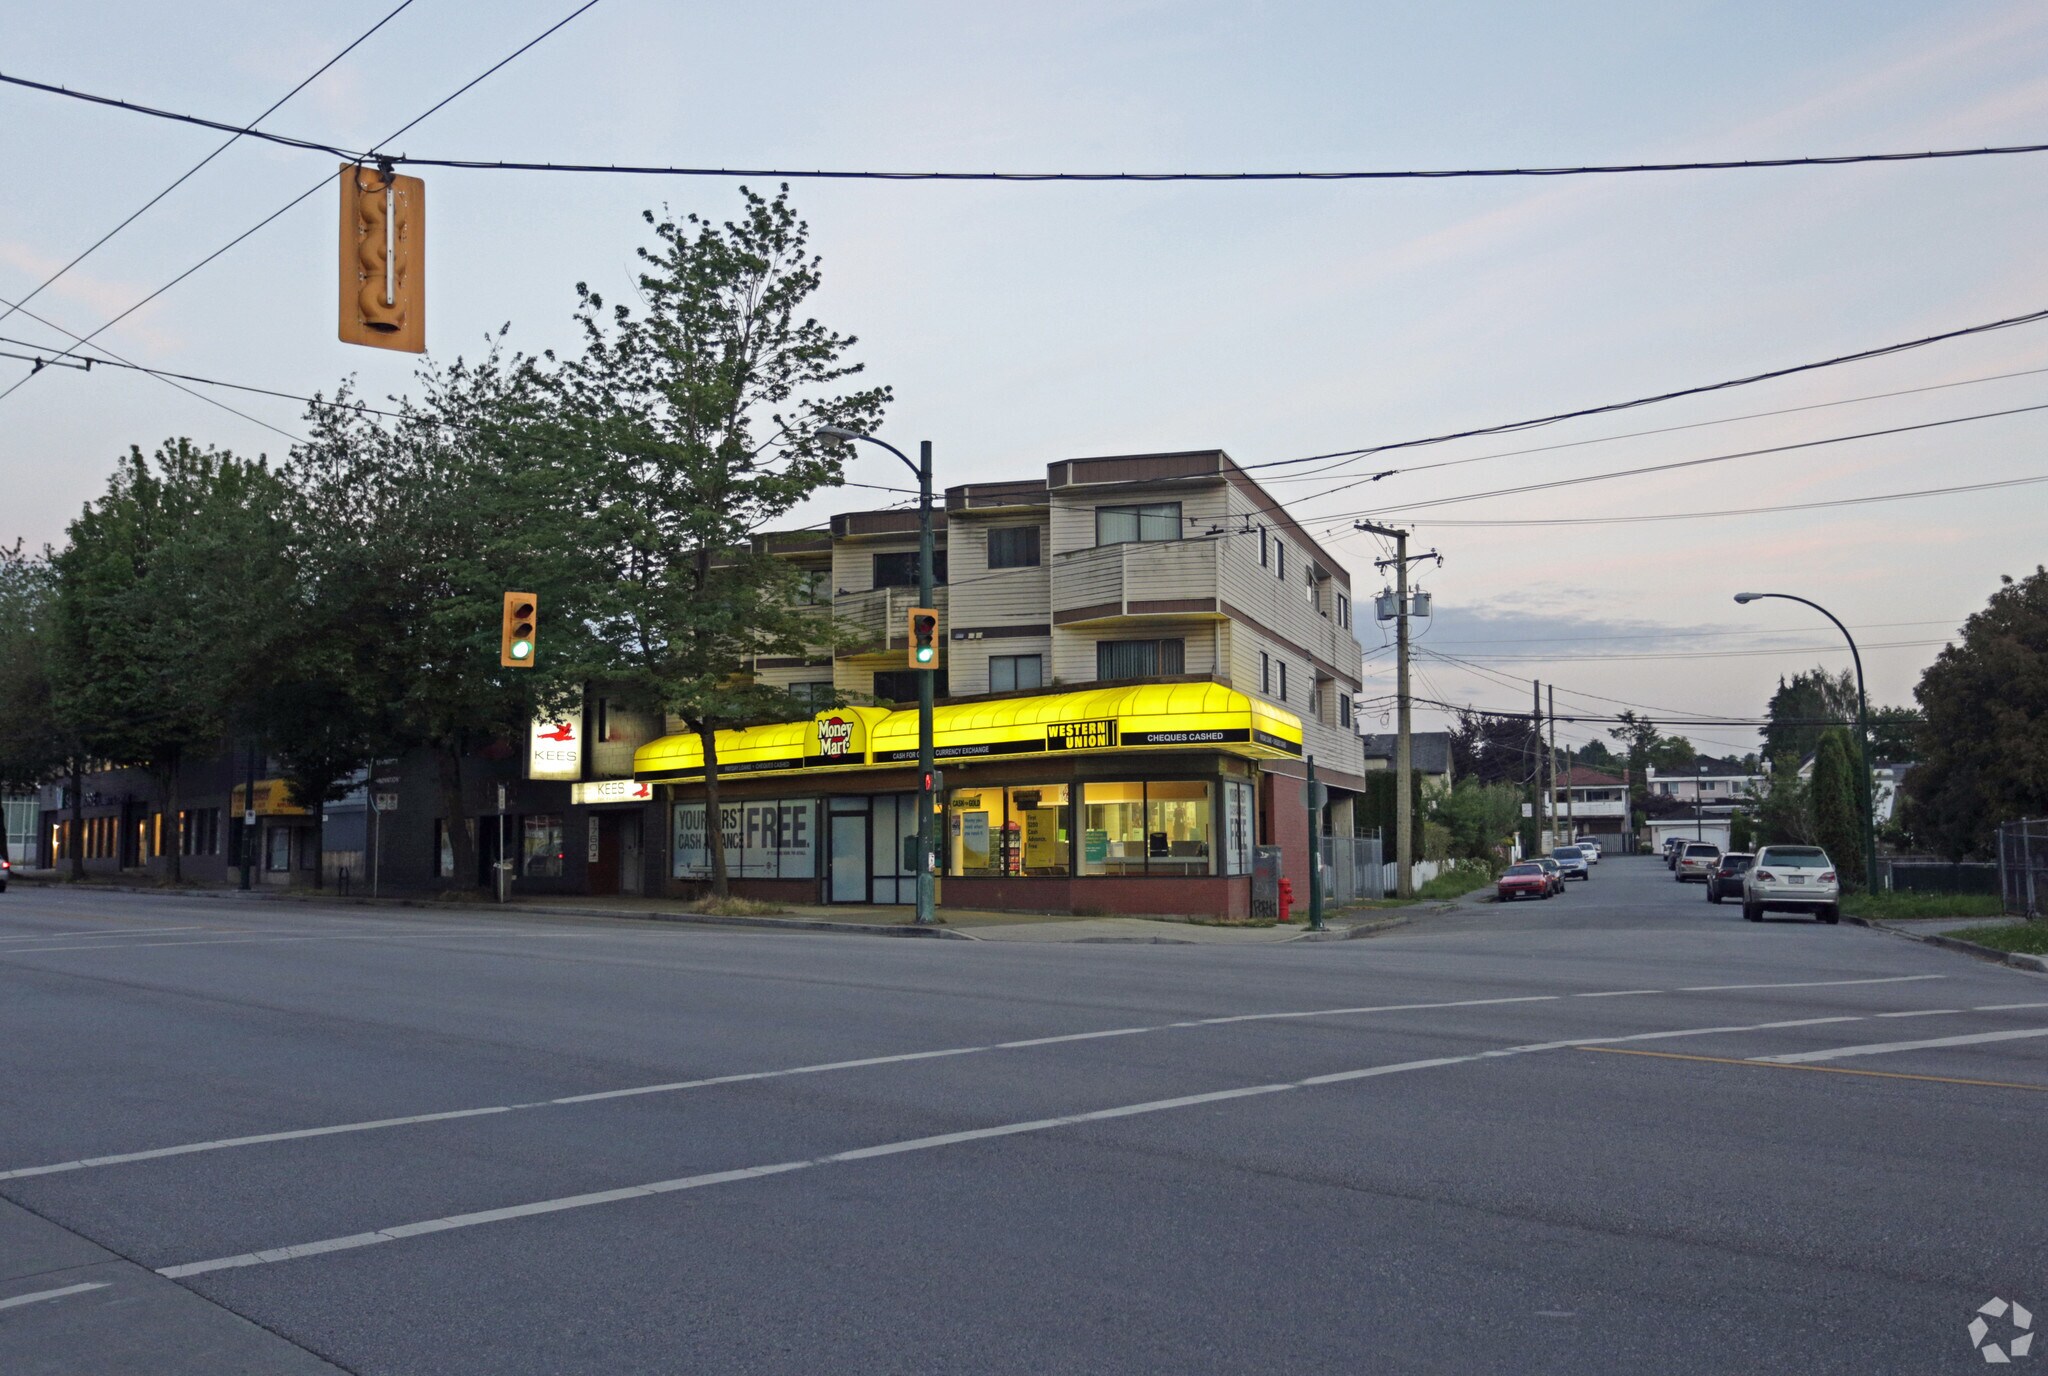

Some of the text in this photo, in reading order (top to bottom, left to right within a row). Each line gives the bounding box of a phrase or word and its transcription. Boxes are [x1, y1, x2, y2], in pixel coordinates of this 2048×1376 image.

[818, 719, 854, 740] Money
[1048, 720, 1106, 738] WESTERN
[1147, 731, 1223, 742] CHEQUES CASHED
[819, 737, 849, 756] Mart
[1065, 733, 1106, 748] UNION
[534, 750, 577, 762] KEES
[892, 752, 906, 760] CASH
[906, 751, 916, 759] FOR
[935, 747, 962, 757] CURRENCY
[962, 745, 990, 755] EXCHANGE
[597, 782, 625, 795] KEES
[952, 799, 964, 807] CASH
[968, 799, 980, 807] GOLD
[679, 809, 706, 830] YOUR
[590, 819, 598, 851] 1760
[678, 834, 701, 850] CASH
